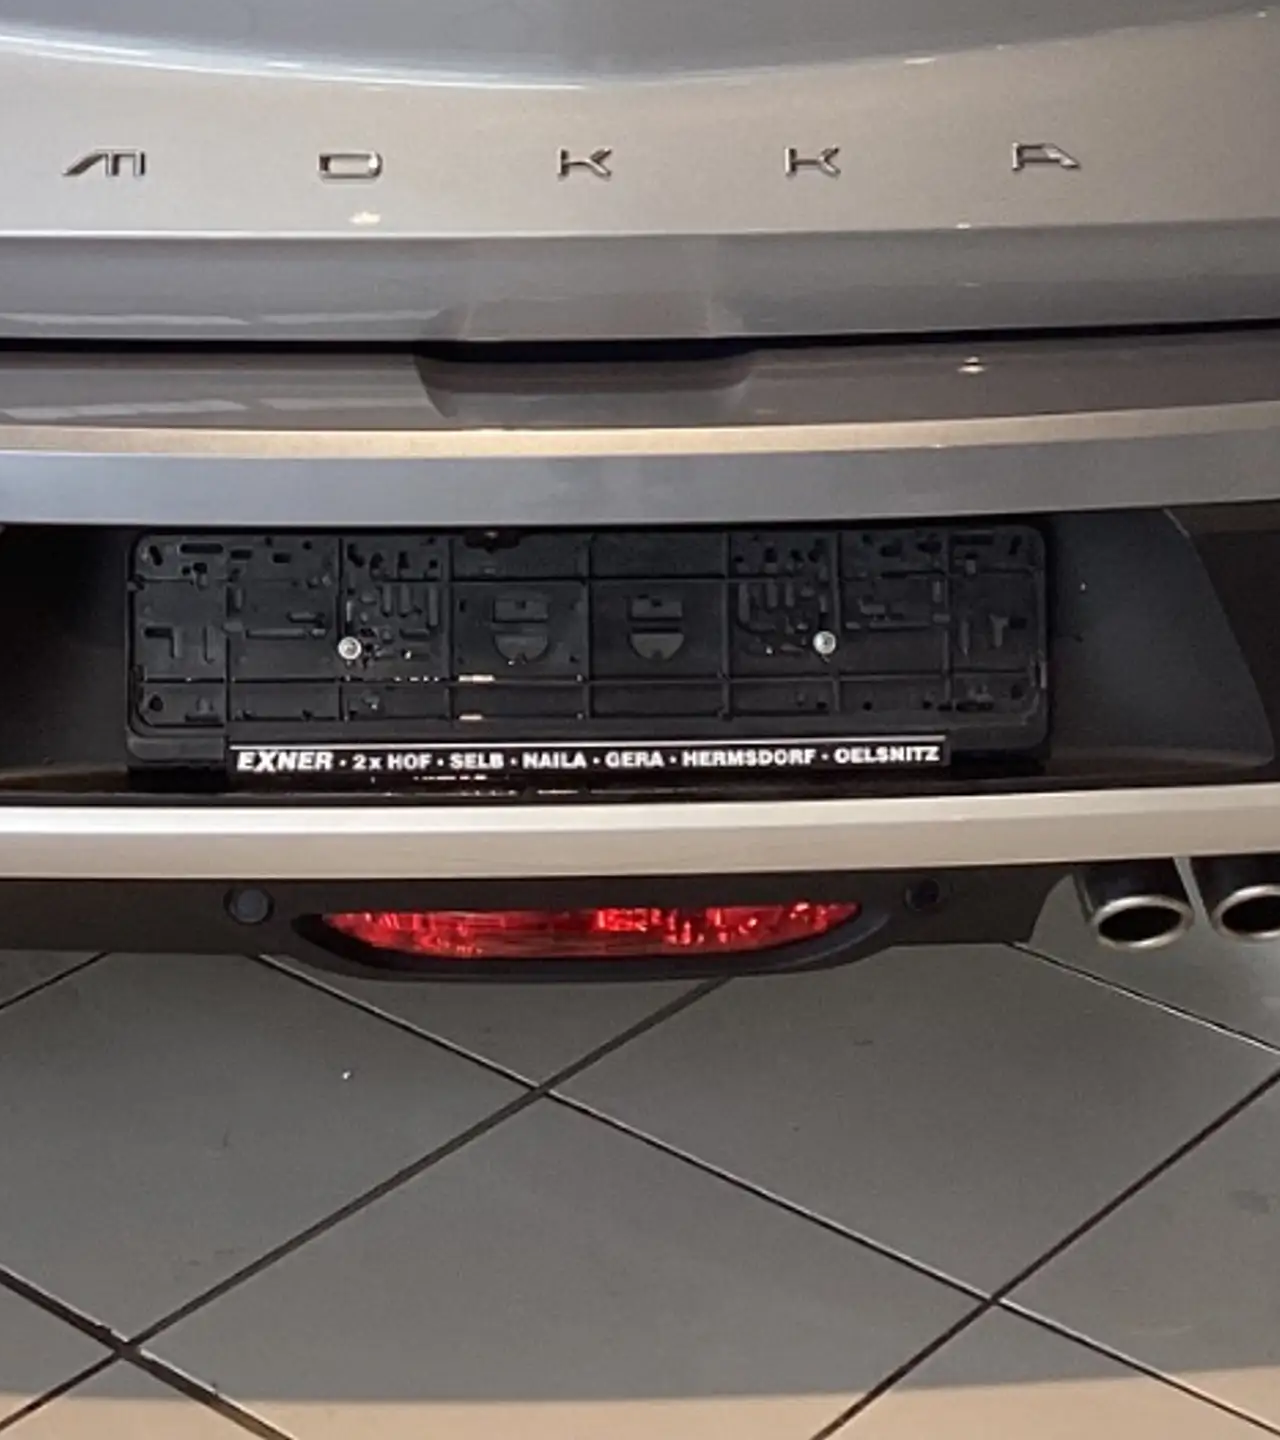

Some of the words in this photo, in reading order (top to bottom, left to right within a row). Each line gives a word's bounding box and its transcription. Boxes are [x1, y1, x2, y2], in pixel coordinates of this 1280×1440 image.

[61, 142, 1081, 178] MOKKA
[236, 751, 335, 773] EXNER
[387, 753, 433, 770] HOF
[450, 752, 504, 769] SELB
[522, 752, 587, 769] NAILA
[604, 751, 664, 768] GERA
[681, 749, 817, 767] HERMSDORF
[834, 746, 940, 763] OELSNITZ
